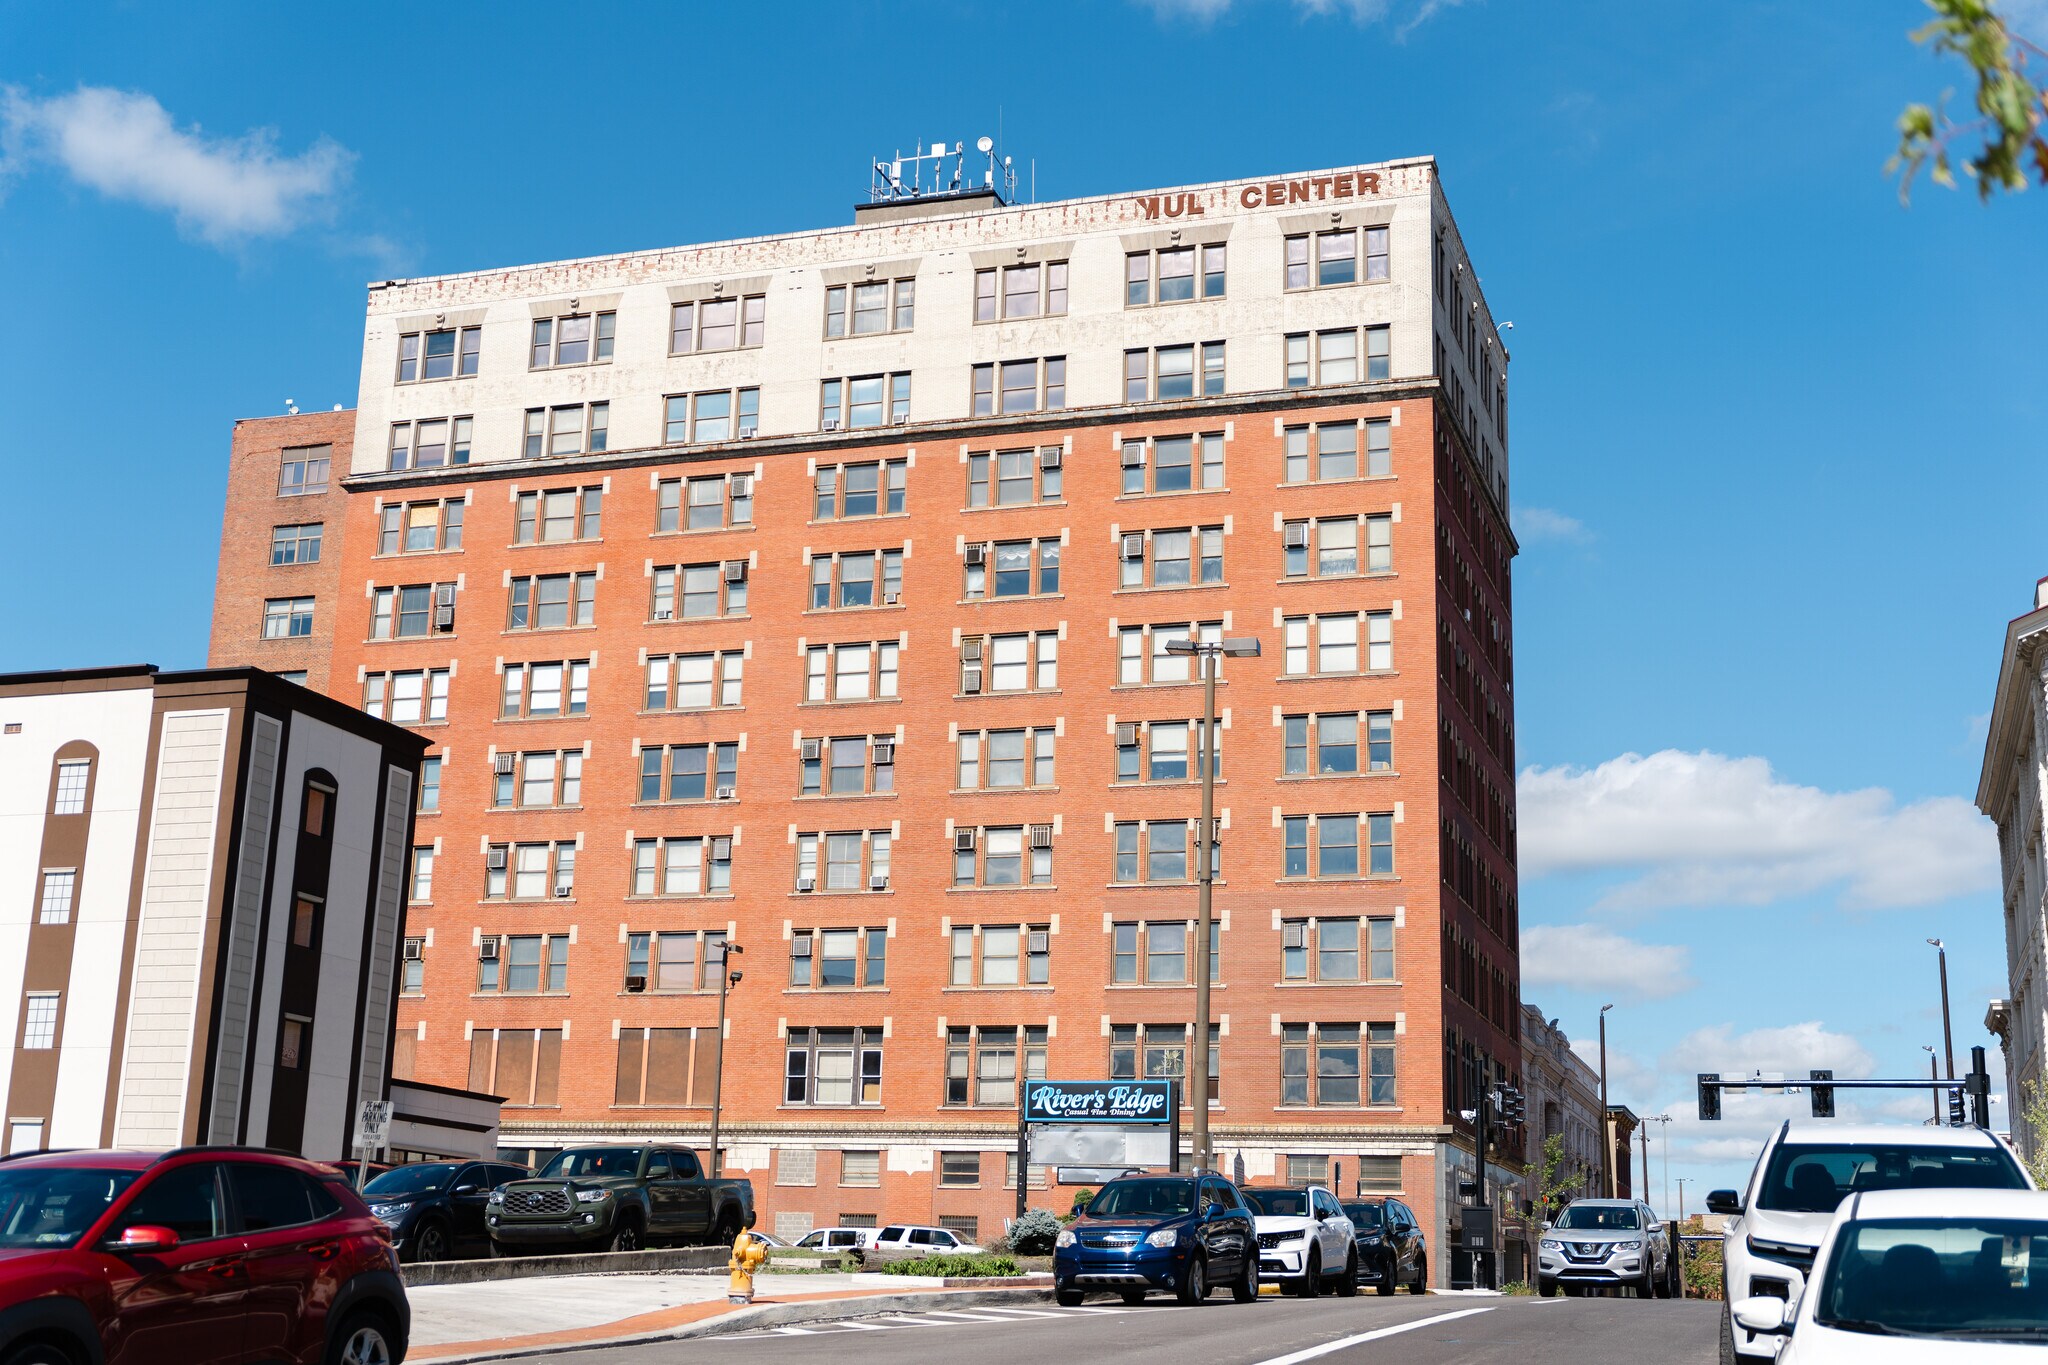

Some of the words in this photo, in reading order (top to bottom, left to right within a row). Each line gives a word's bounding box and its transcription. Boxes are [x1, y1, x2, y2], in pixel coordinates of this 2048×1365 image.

[1240, 172, 1379, 209] CENTER
[1031, 1085, 1105, 1115] River's
[1108, 1085, 1164, 1114] Edge
[365, 1101, 389, 1112] PERMIT
[1064, 1108, 1089, 1117] Casual
[1091, 1108, 1107, 1116] Fine
[1109, 1108, 1136, 1117] Dining
[361, 1111, 388, 1123] PARKING
[364, 1122, 380, 1134] ONLY
